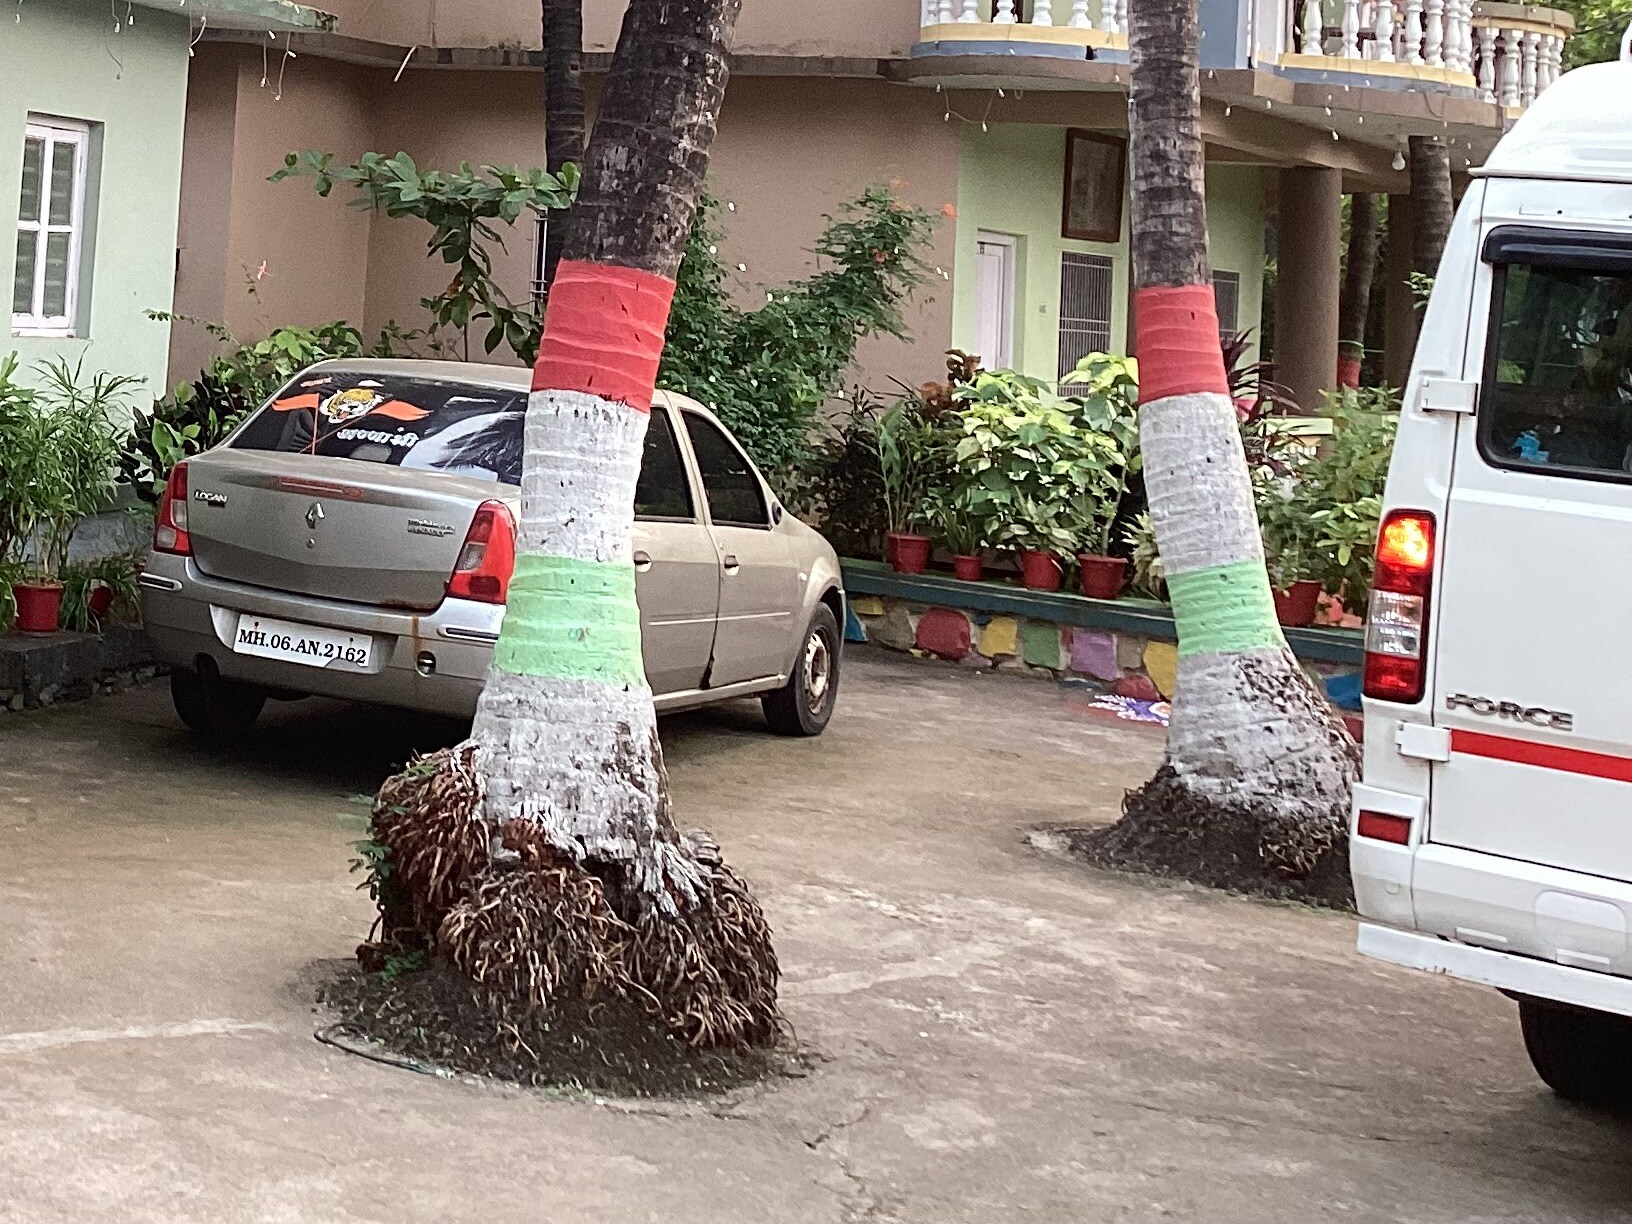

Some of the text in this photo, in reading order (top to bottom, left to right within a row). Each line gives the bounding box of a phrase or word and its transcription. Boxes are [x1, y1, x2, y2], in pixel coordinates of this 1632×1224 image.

[194, 490, 228, 503] LOGAN
[238, 629, 367, 664] MH.06.AN.2162
[1446, 692, 1574, 732] FORCE
